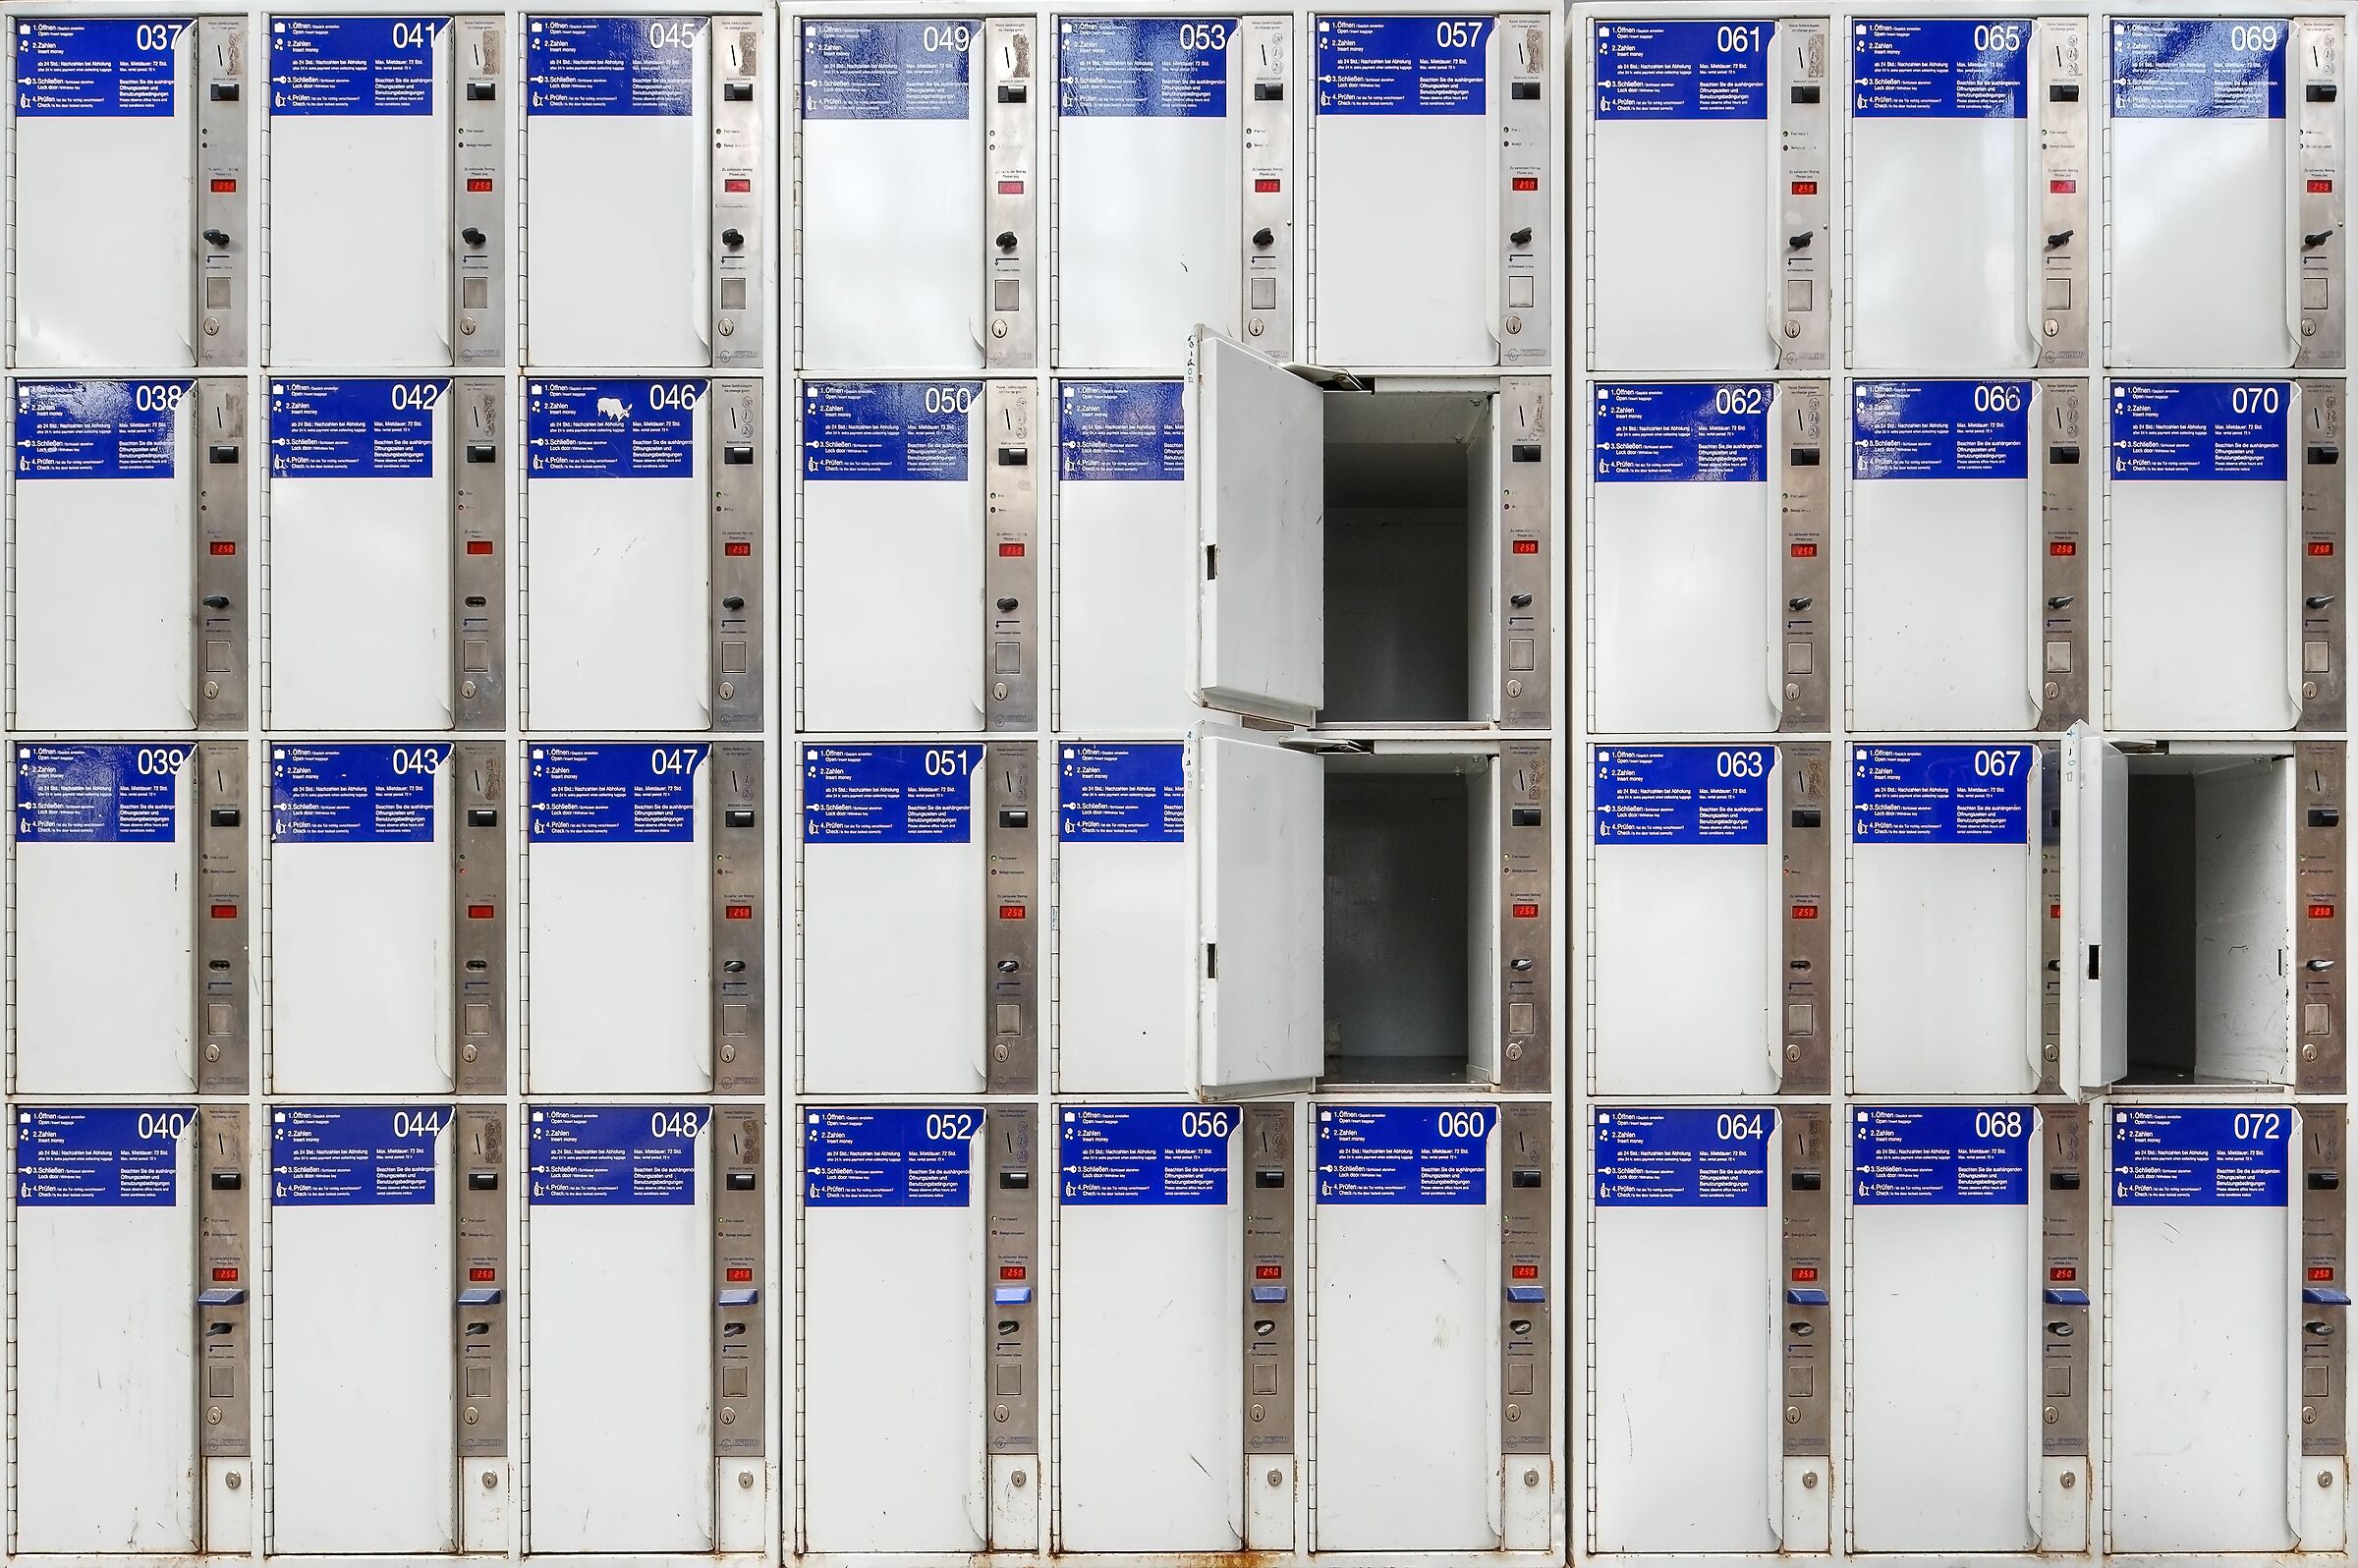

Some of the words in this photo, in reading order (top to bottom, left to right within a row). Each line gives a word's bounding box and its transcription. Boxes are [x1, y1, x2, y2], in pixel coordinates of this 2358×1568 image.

[138, 25, 183, 50] 037
[394, 23, 437, 48] 041
[650, 23, 696, 48] 045
[924, 26, 969, 51] 049
[1180, 24, 1225, 49] 053
[1437, 22, 1483, 47] 057
[1718, 27, 1762, 52] 061
[1975, 25, 2020, 50] 065
[2232, 26, 2277, 51] 069
[137, 385, 182, 411] 038
[392, 384, 437, 410] 042
[650, 384, 696, 410] 046
[926, 387, 971, 413] 050
[1716, 388, 1762, 414] 062
[1975, 386, 2020, 412] 066
[2233, 387, 2278, 413] 070
[139, 749, 184, 774] 039
[394, 749, 439, 774] 043
[652, 749, 698, 774] 047
[926, 750, 969, 775] 051
[1717, 752, 1763, 777] 063
[1975, 751, 2020, 776] 067
[139, 1113, 184, 1139] 040
[395, 1111, 440, 1137] 044
[652, 1112, 698, 1138] 048
[926, 1114, 972, 1140] 052
[1182, 1111, 1227, 1137] 056
[1438, 1111, 1484, 1137] 060
[1717, 1114, 1763, 1140] 064
[1976, 1112, 2021, 1138] 068
[2235, 1113, 2280, 1139] 072
